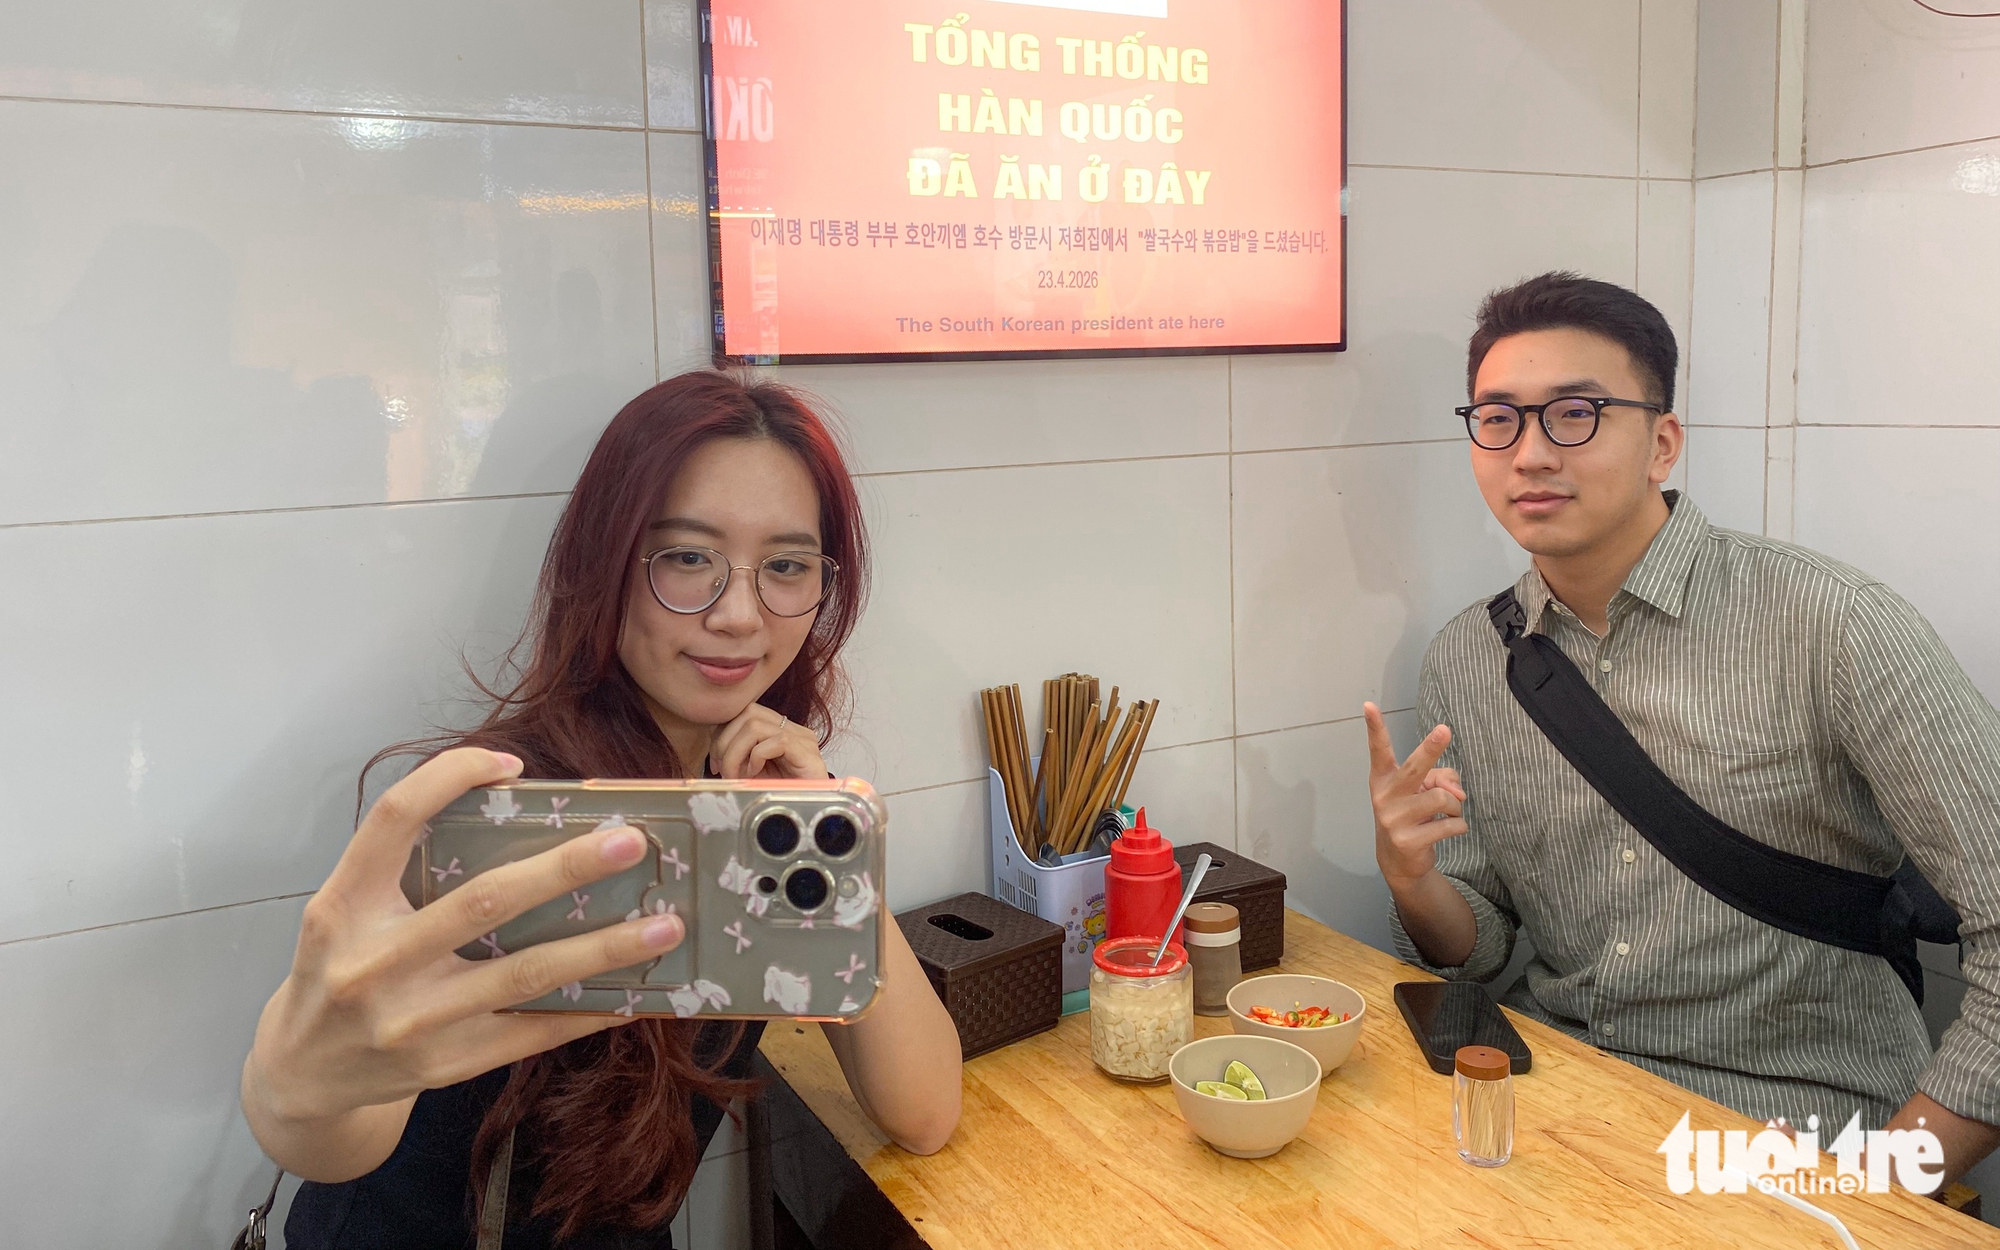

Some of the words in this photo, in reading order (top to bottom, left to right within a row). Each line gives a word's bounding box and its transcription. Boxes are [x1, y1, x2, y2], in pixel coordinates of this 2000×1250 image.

[904, 12, 1040, 72] TỔNG
[1056, 31, 1208, 84] THỐNG
[938, 88, 1043, 137] HÀN
[1059, 94, 1184, 144] QUỐC
[907, 152, 978, 198] ĐÃ
[993, 154, 1062, 201] ĂN
[1079, 153, 1110, 203] Ở
[1123, 161, 1211, 205] ĐÂY
[751, 218, 802, 246] 이재명
[810, 219, 859, 247] 대통령
[866, 221, 899, 248] 부부
[904, 222, 967, 250] 호안끼엠
[973, 224, 1003, 250] 호수
[1009, 225, 1051, 251] 방문시
[1058, 226, 1128, 251] 저희집에서
[1263, 230, 1329, 254] 드셨습니다.
[1038, 270, 1098, 289] 23.4.2026
[896, 317, 933, 333] The
[939, 316, 994, 332] South
[1001, 316, 1065, 332] Korean
[1071, 315, 1153, 334] president
[1158, 316, 1184, 330] ate
[1189, 315, 1225, 329] here
